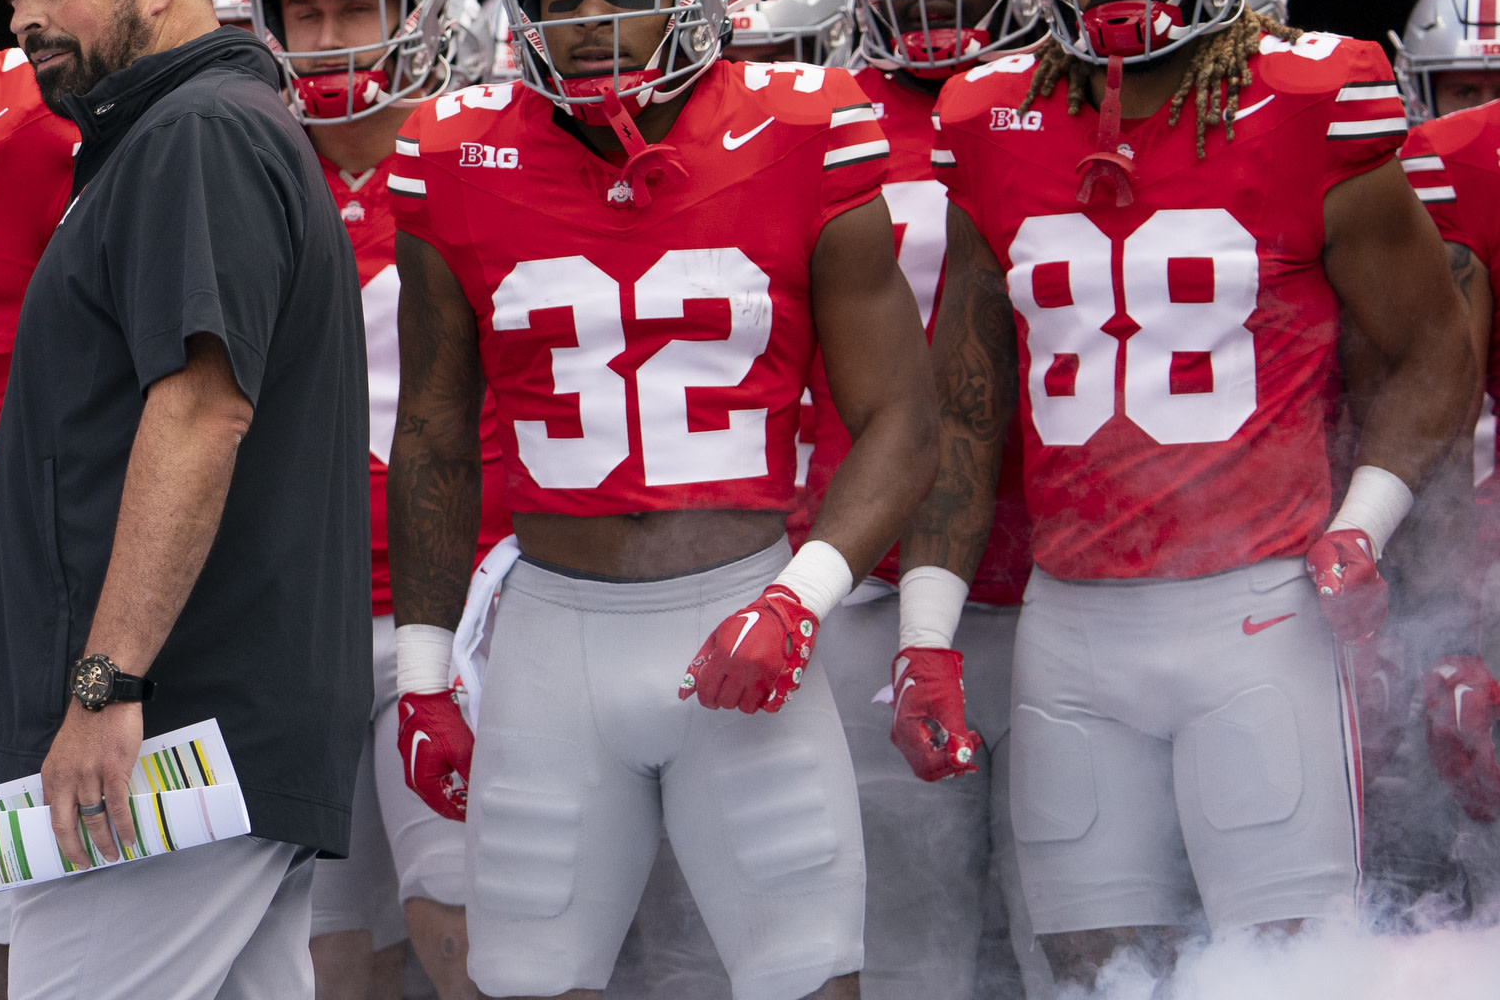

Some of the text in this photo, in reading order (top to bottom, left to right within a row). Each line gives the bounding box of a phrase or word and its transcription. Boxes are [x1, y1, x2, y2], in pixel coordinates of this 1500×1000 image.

[459, 142, 519, 169] B1G
[492, 247, 772, 490] 32
[1006, 208, 1259, 446] 88
